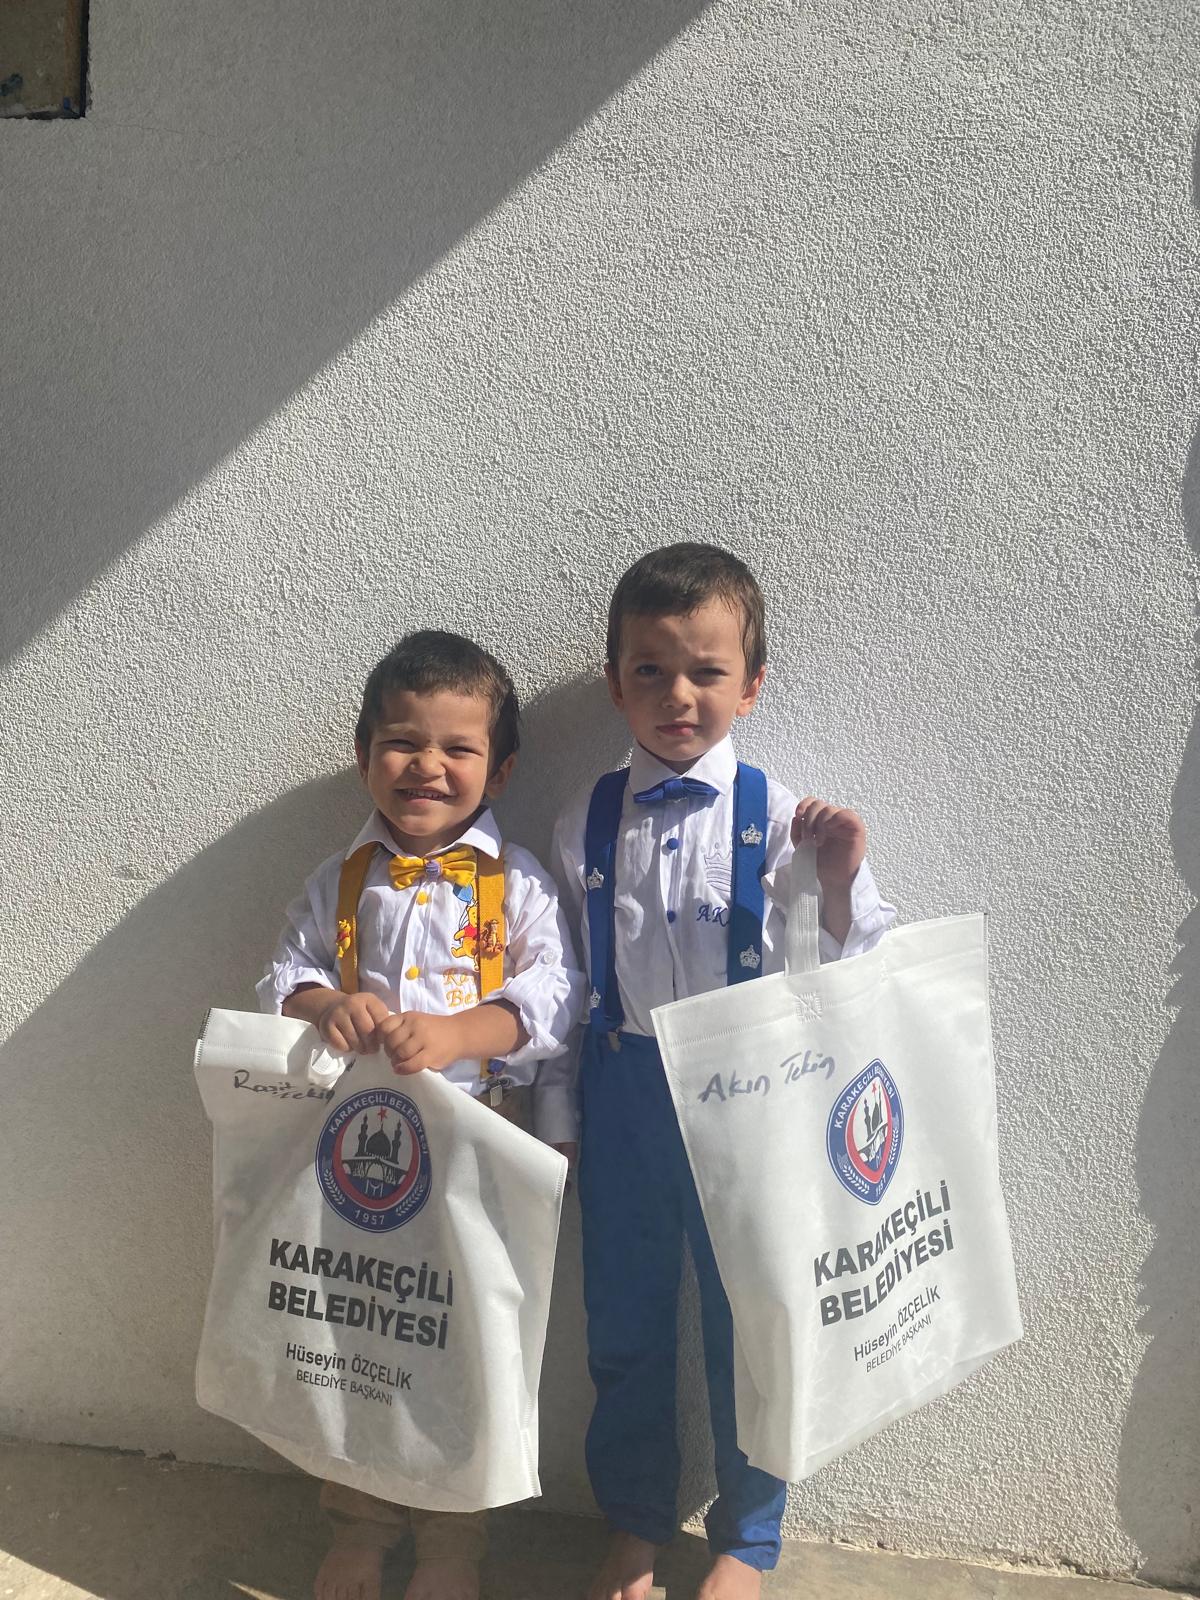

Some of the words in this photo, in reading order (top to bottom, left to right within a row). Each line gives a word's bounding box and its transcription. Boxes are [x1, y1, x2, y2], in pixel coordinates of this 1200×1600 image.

[354, 1209, 385, 1226] 1957
[814, 1179, 951, 1288] KARAKEÇİLİ
[269, 1238, 454, 1306] KARAKEÇİLİ
[820, 1218, 955, 1327] BELEDİYESİ
[268, 1281, 449, 1350] BELEDİYESİ
[853, 1323, 898, 1361] Hüseyin
[897, 1285, 941, 1328] ÖZÇELİK
[866, 1339, 902, 1373] BELEDİYE
[901, 1313, 932, 1346] BAŞKANI
[286, 1342, 346, 1371] Hüseyin
[351, 1353, 413, 1391] ÖZÇELİK
[296, 1369, 348, 1391] BELEDİYE
[349, 1380, 394, 1407] BAŞKANI
